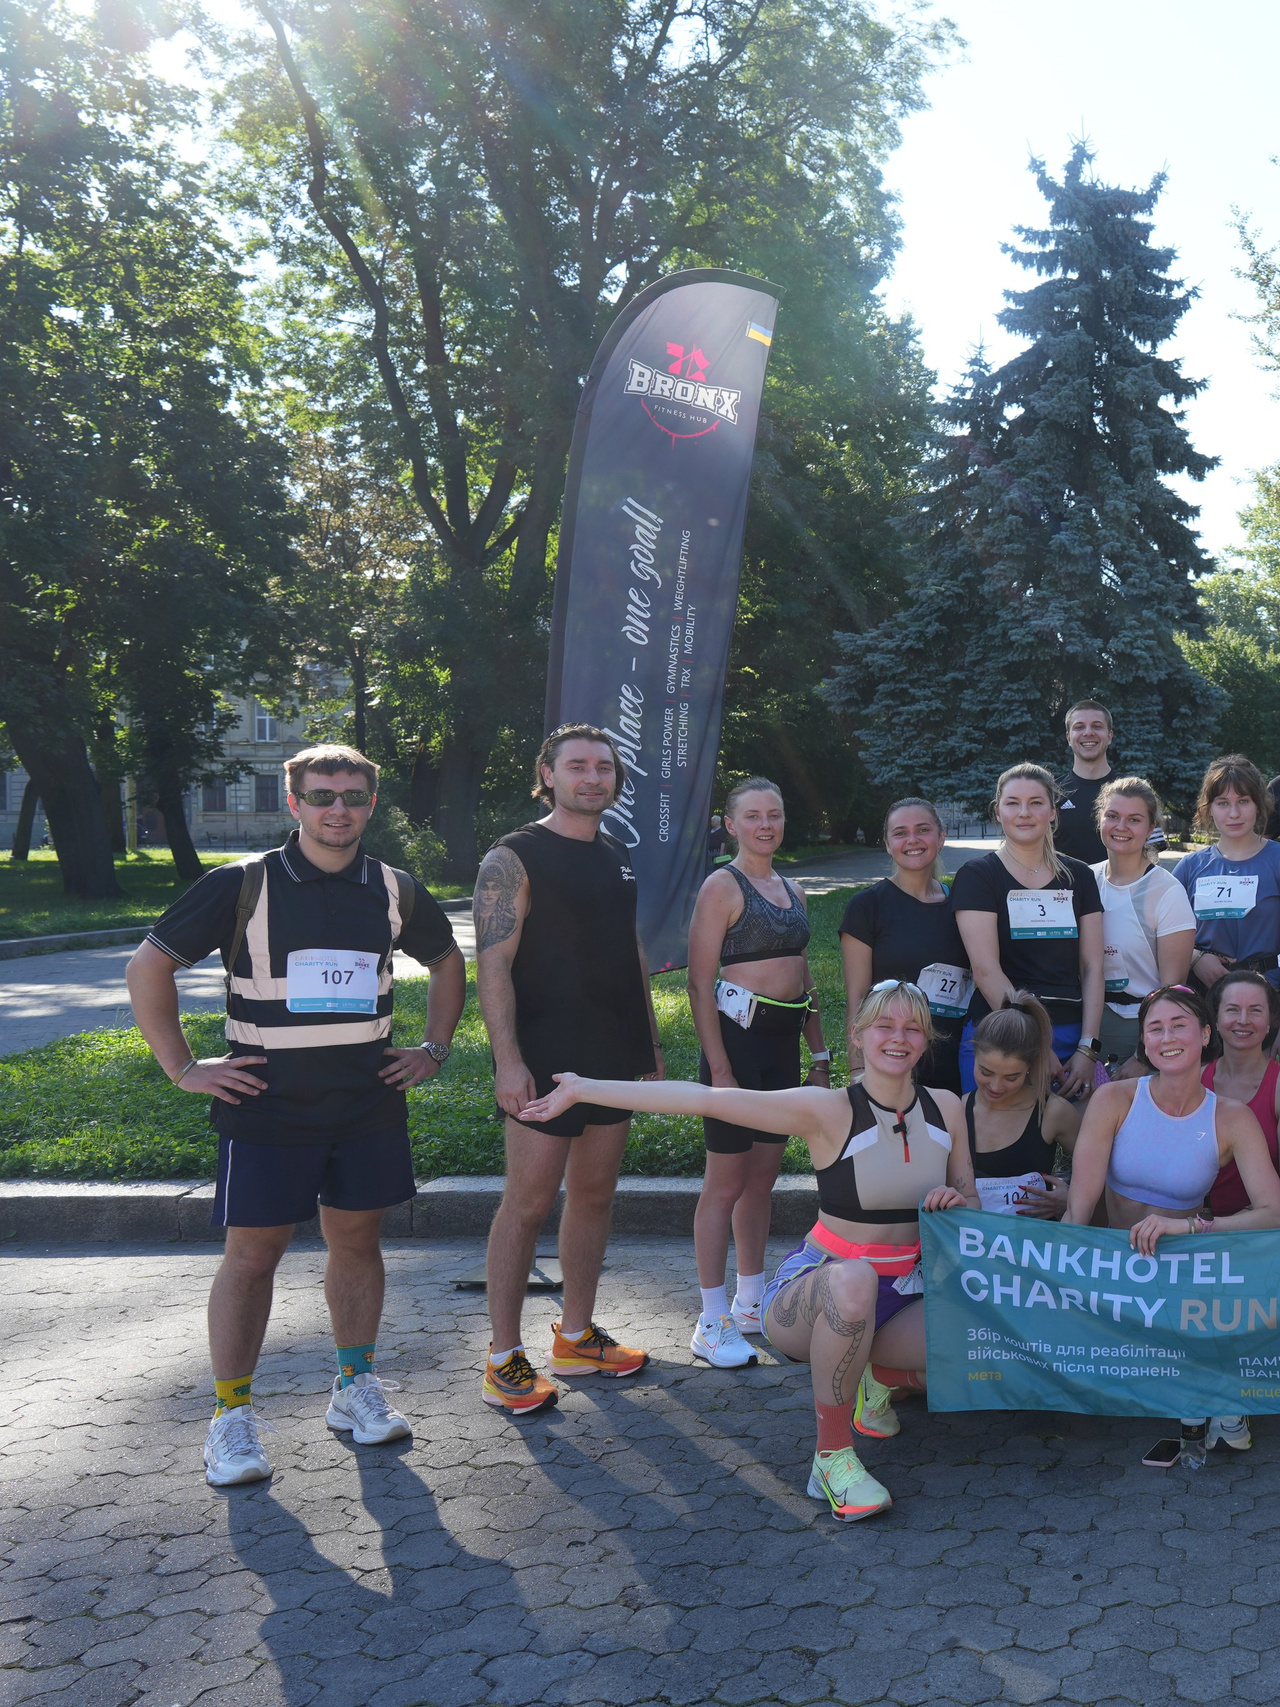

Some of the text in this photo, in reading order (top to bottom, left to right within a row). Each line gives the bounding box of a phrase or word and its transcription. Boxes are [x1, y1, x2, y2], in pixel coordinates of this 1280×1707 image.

[624, 358, 741, 425] BRONX
[654, 405, 708, 424] FITNESS HUB
[621, 496, 664, 589] goal!
[621, 587, 651, 646] one
[659, 530, 691, 842] CROSSFIT GIRLS POWER GYMNASTICS WEIGHTLIFTING
[677, 604, 697, 767] STRETCHING TRX MOBILITY
[603, 683, 648, 777] place
[1038, 905, 1046, 916] 3
[1217, 887, 1232, 898] 71
[321, 970, 354, 984] 107
[940, 979, 957, 993] 27
[958, 1226, 1245, 1284] BANKHOTEL
[960, 1269, 1277, 1331] CHARITY RUN
[967, 1328, 1001, 1343] Збір
[1004, 1335, 1051, 1353] коштів
[1056, 1345, 1085, 1356] для
[968, 1347, 1180, 1379] військових після поранень
[968, 1372, 1001, 1381] мета
